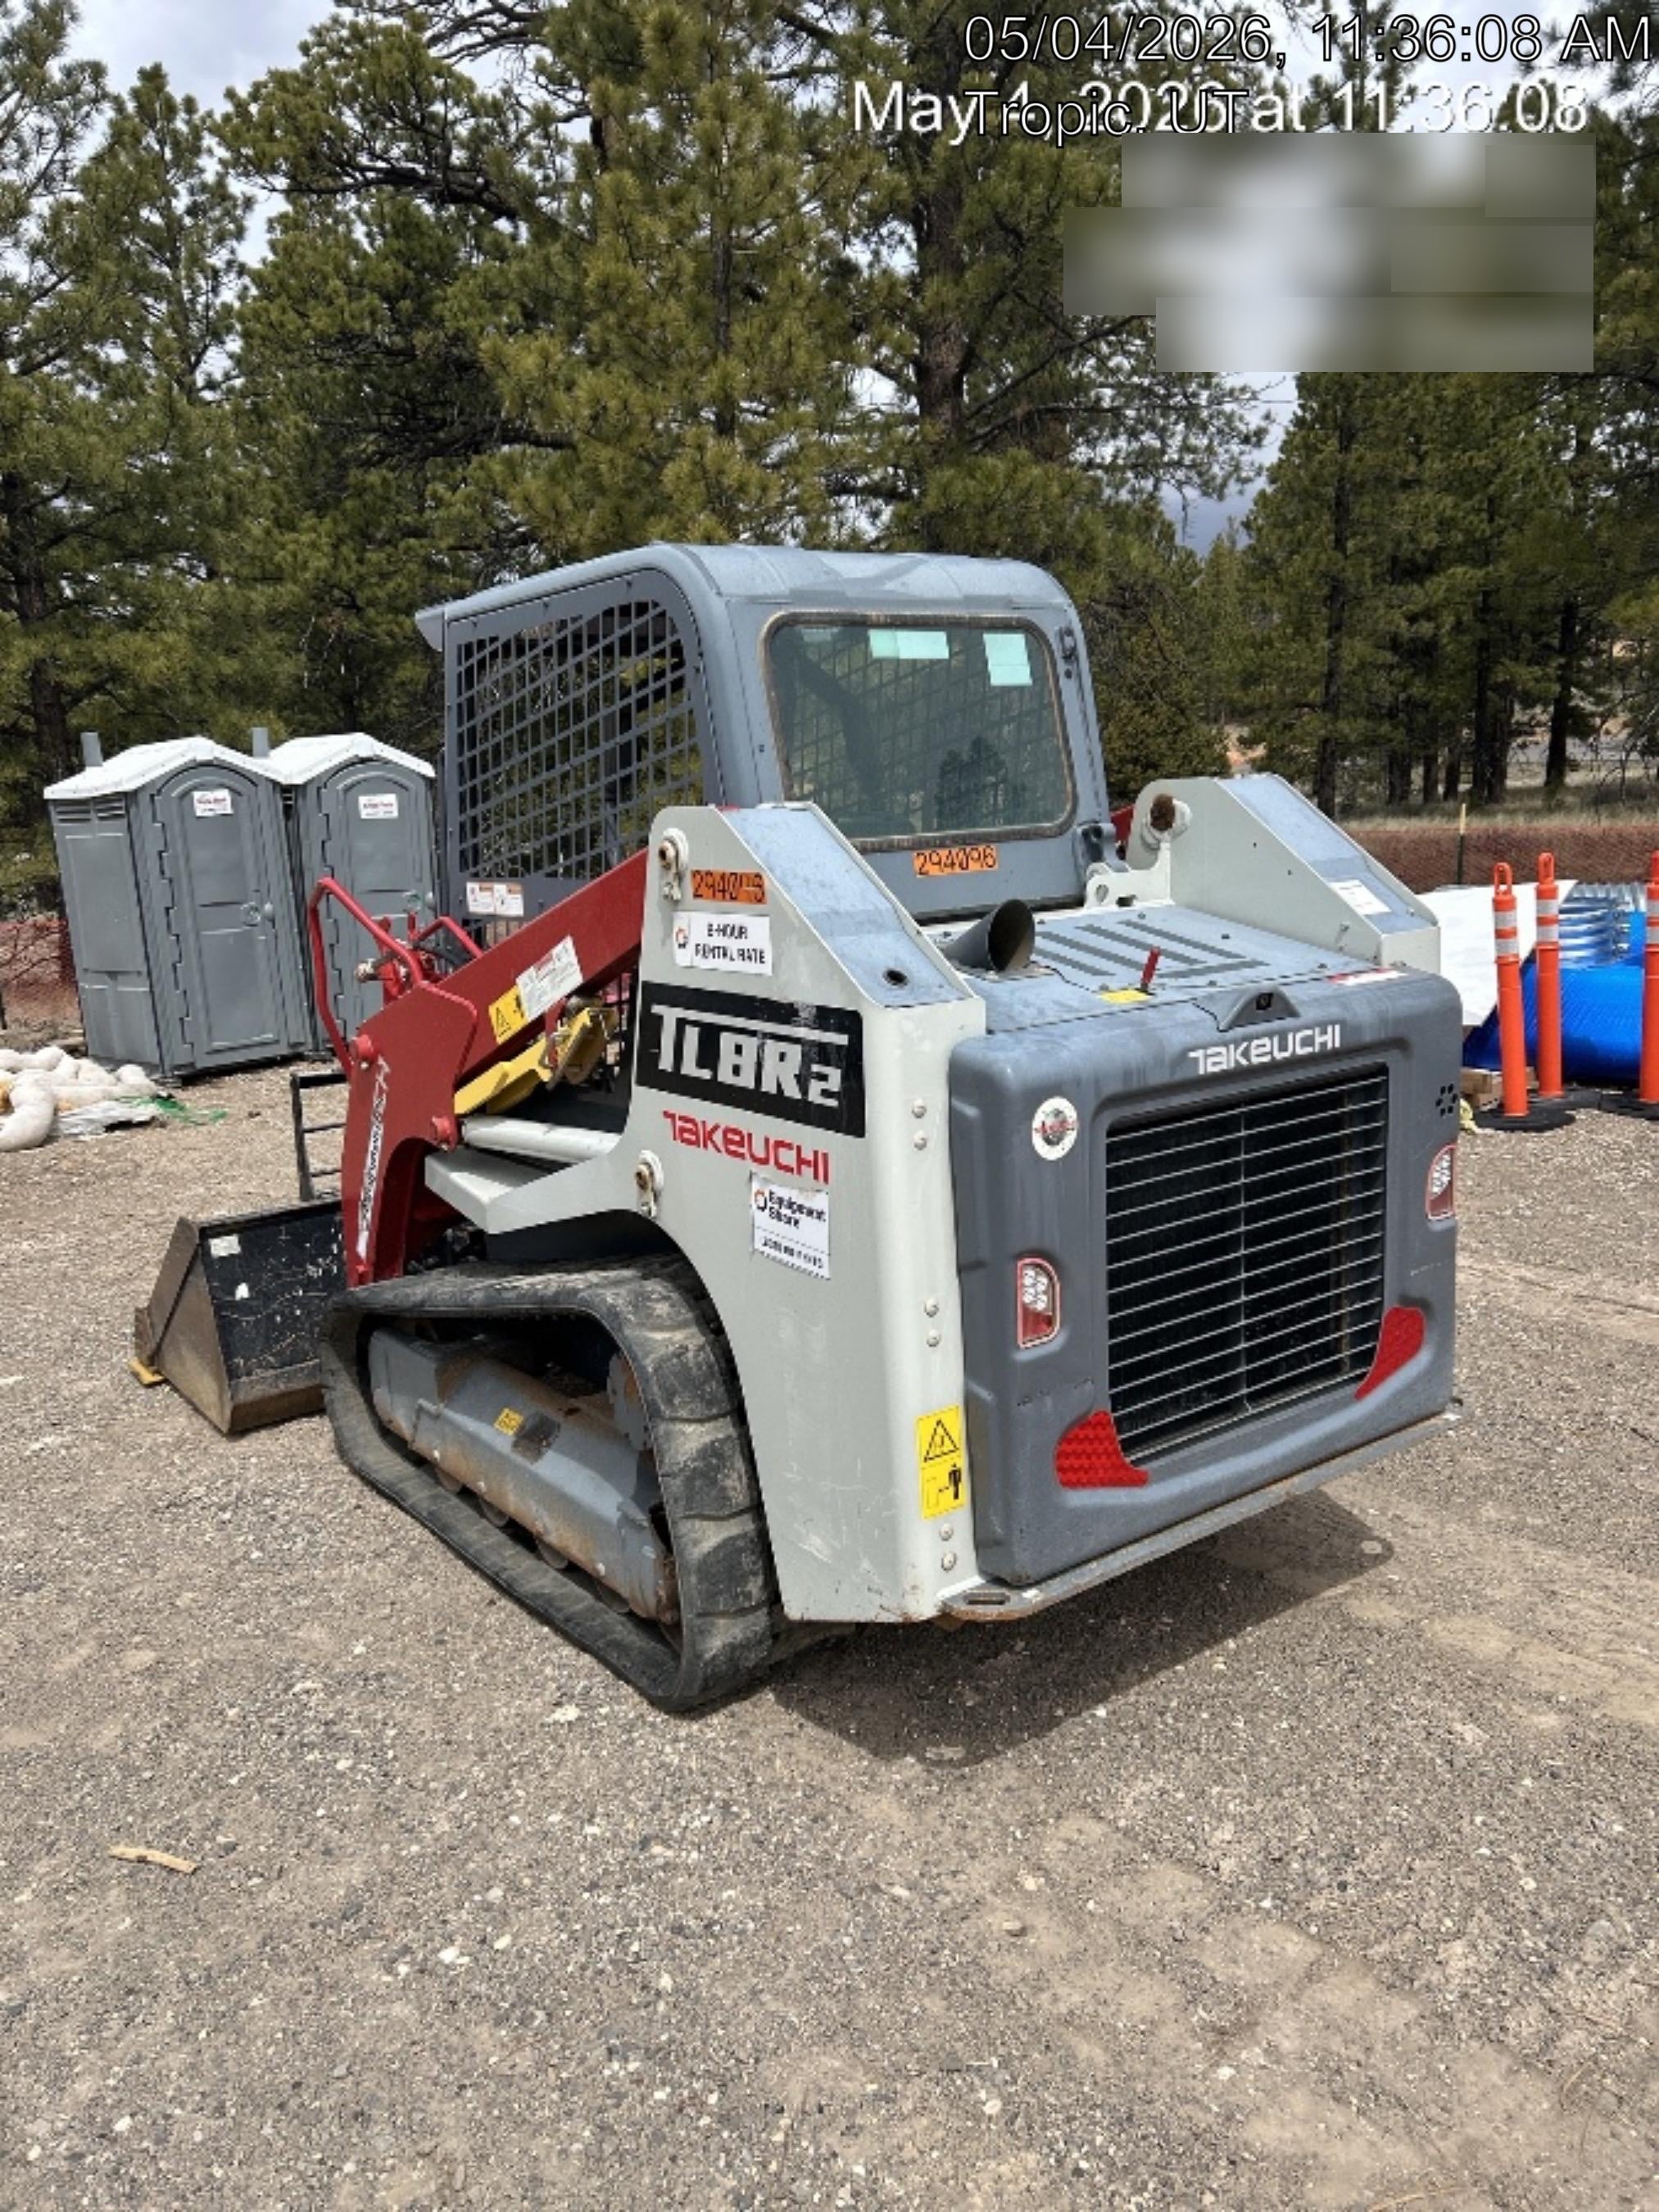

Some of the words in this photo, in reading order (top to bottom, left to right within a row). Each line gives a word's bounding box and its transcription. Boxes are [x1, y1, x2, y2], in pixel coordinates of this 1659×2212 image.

[737, 947, 767, 965] RATE
[1188, 1024, 1341, 1076] TAKEUCHI
[663, 1109, 829, 1185] TAKEUCHI
